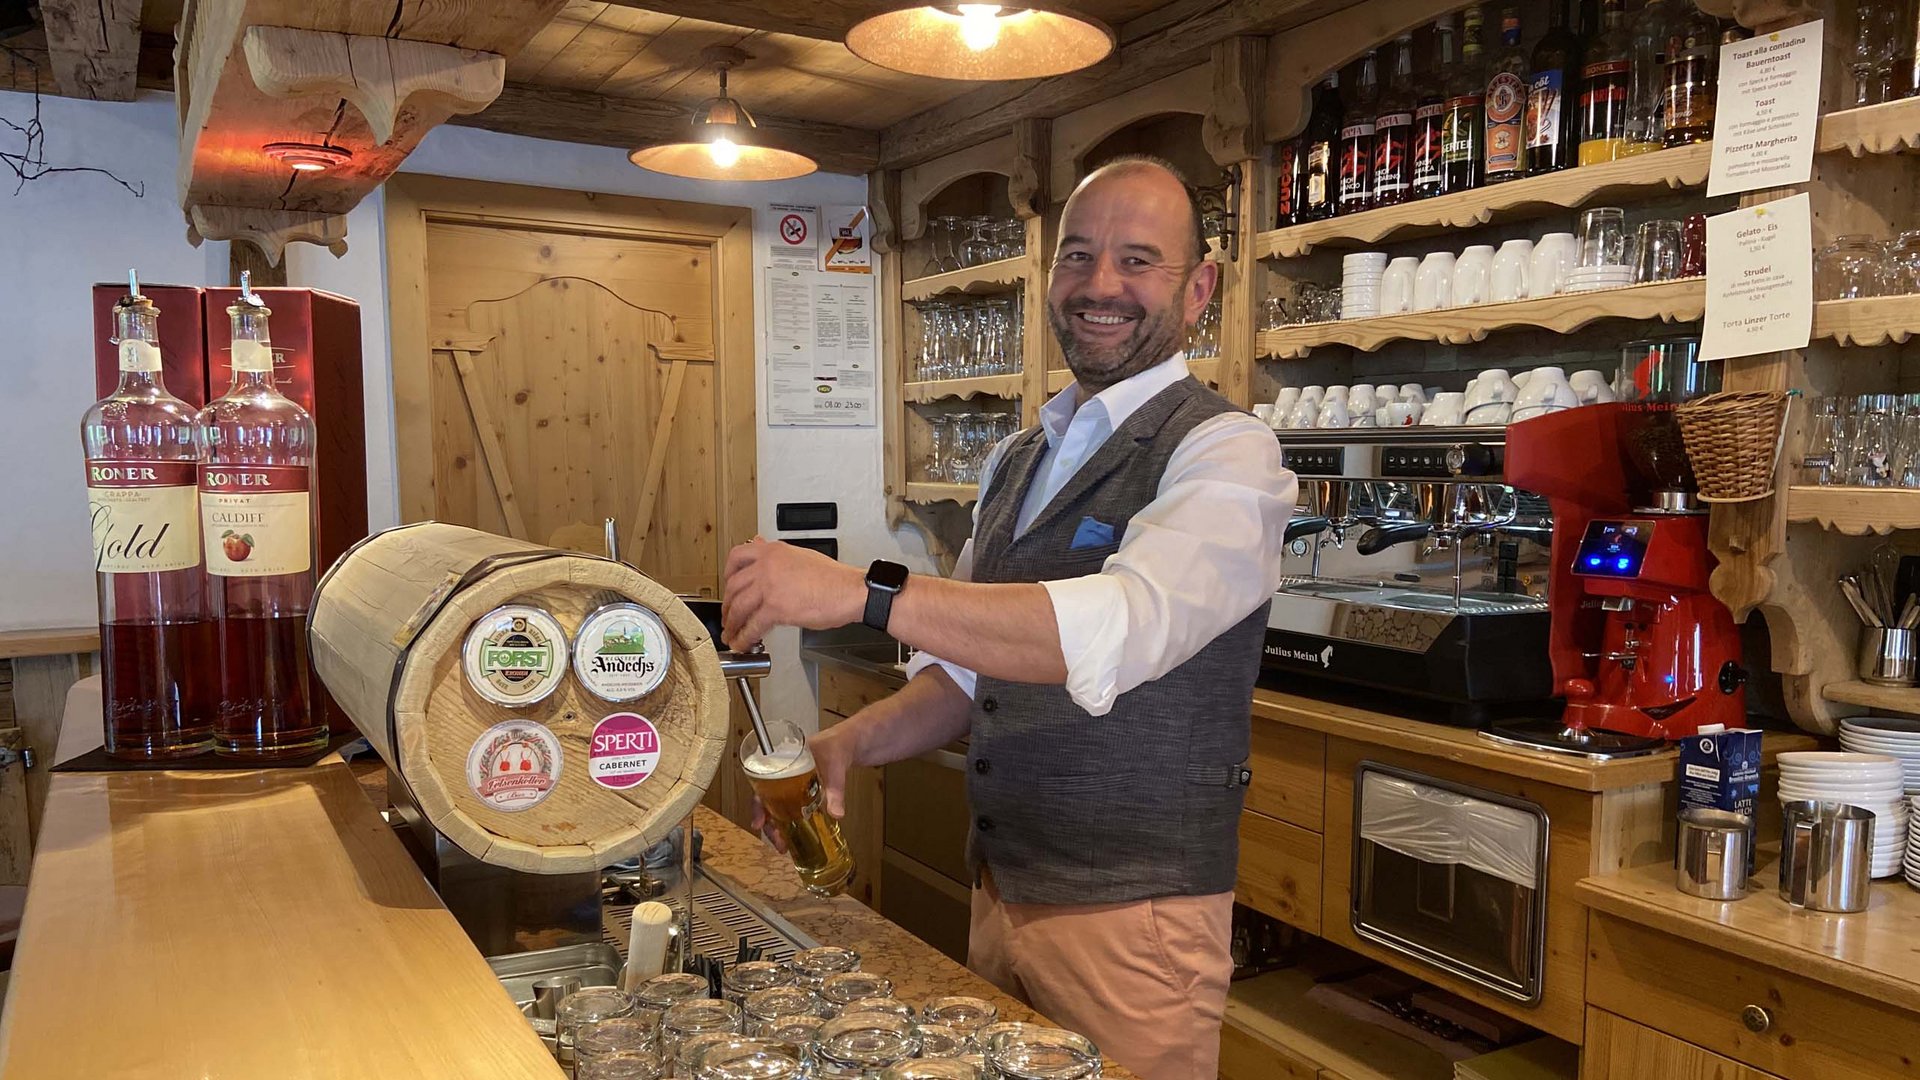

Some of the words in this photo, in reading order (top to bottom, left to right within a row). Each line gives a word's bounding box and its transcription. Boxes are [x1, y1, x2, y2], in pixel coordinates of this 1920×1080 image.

[1733, 49, 1753, 60] Toast
[1754, 46, 1767, 56] alla
[1769, 37, 1806, 52] contadina
[1746, 52, 1791, 68] Bauerntoast
[1756, 98, 1776, 108] Toast
[1725, 143, 1754, 154] Pizzetta
[1756, 135, 1798, 148] Margherita
[1736, 228, 1762, 238] Gelato
[1768, 224, 1778, 232] Eis
[1744, 265, 1772, 278] Strudel
[1722, 319, 1742, 328] Torta
[1744, 315, 1766, 325] Linzer
[1770, 312, 1790, 320] Torte
[90, 466, 158, 482] RONER
[206, 472, 272, 487] RONER
[212, 512, 266, 524] CALDIFF
[88, 500, 170, 572] Gold
[488, 650, 548, 668] FORST
[1264, 645, 1292, 658] Julius
[1294, 650, 1318, 662] Meinl
[590, 656, 655, 678] Andechs
[594, 732, 652, 752] SPERTI
[599, 760, 648, 770] CABERNET
[1734, 798, 1752, 809] LATTE
